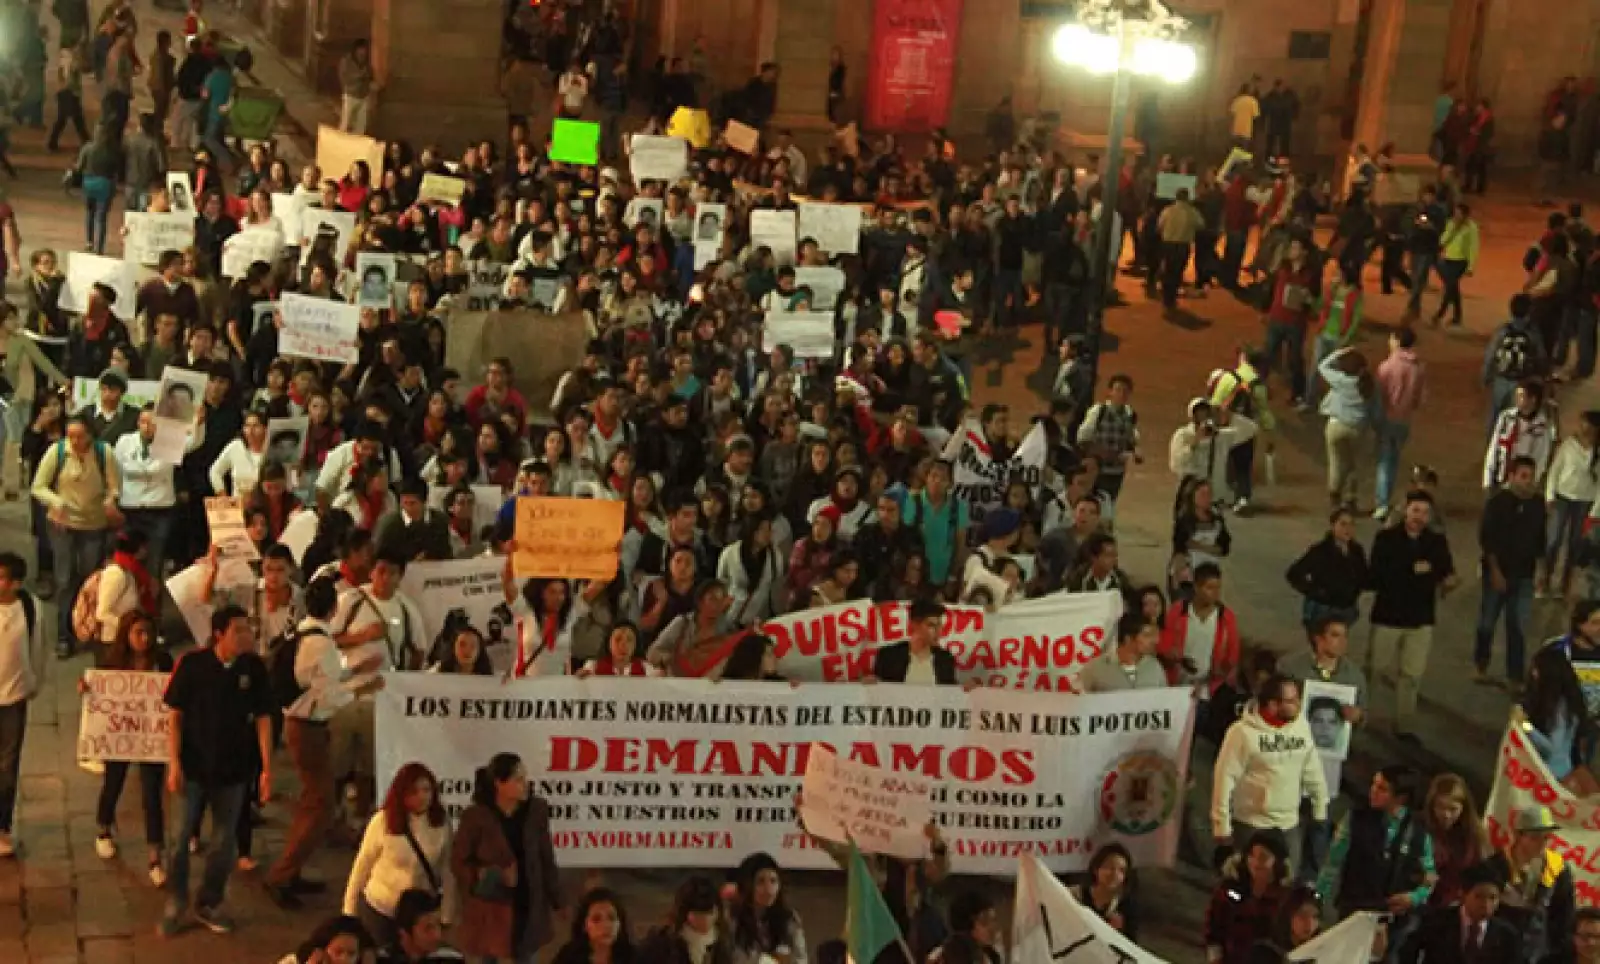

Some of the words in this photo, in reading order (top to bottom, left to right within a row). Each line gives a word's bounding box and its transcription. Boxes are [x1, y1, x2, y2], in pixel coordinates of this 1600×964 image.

[405, 696, 451, 718] LOS
[459, 698, 618, 722] ESTUDIANTES
[625, 700, 789, 727] NORMALISTAS
[795, 705, 835, 726] DEL
[842, 706, 932, 728] ESTADO
[941, 708, 972, 729] DE
[979, 709, 1023, 733] SAN
[1030, 711, 1082, 736] LUIS
[1088, 709, 1172, 735] POTOSI
[580, 779, 662, 798] JUSTO
[667, 780, 686, 798] Y
[691, 782, 800, 800] TRANSP
[955, 788, 1028, 809] COMO
[1036, 791, 1065, 809] LA
[587, 804, 721, 822] NUESTROS
[552, 830, 734, 849] OYNORMALISTA
